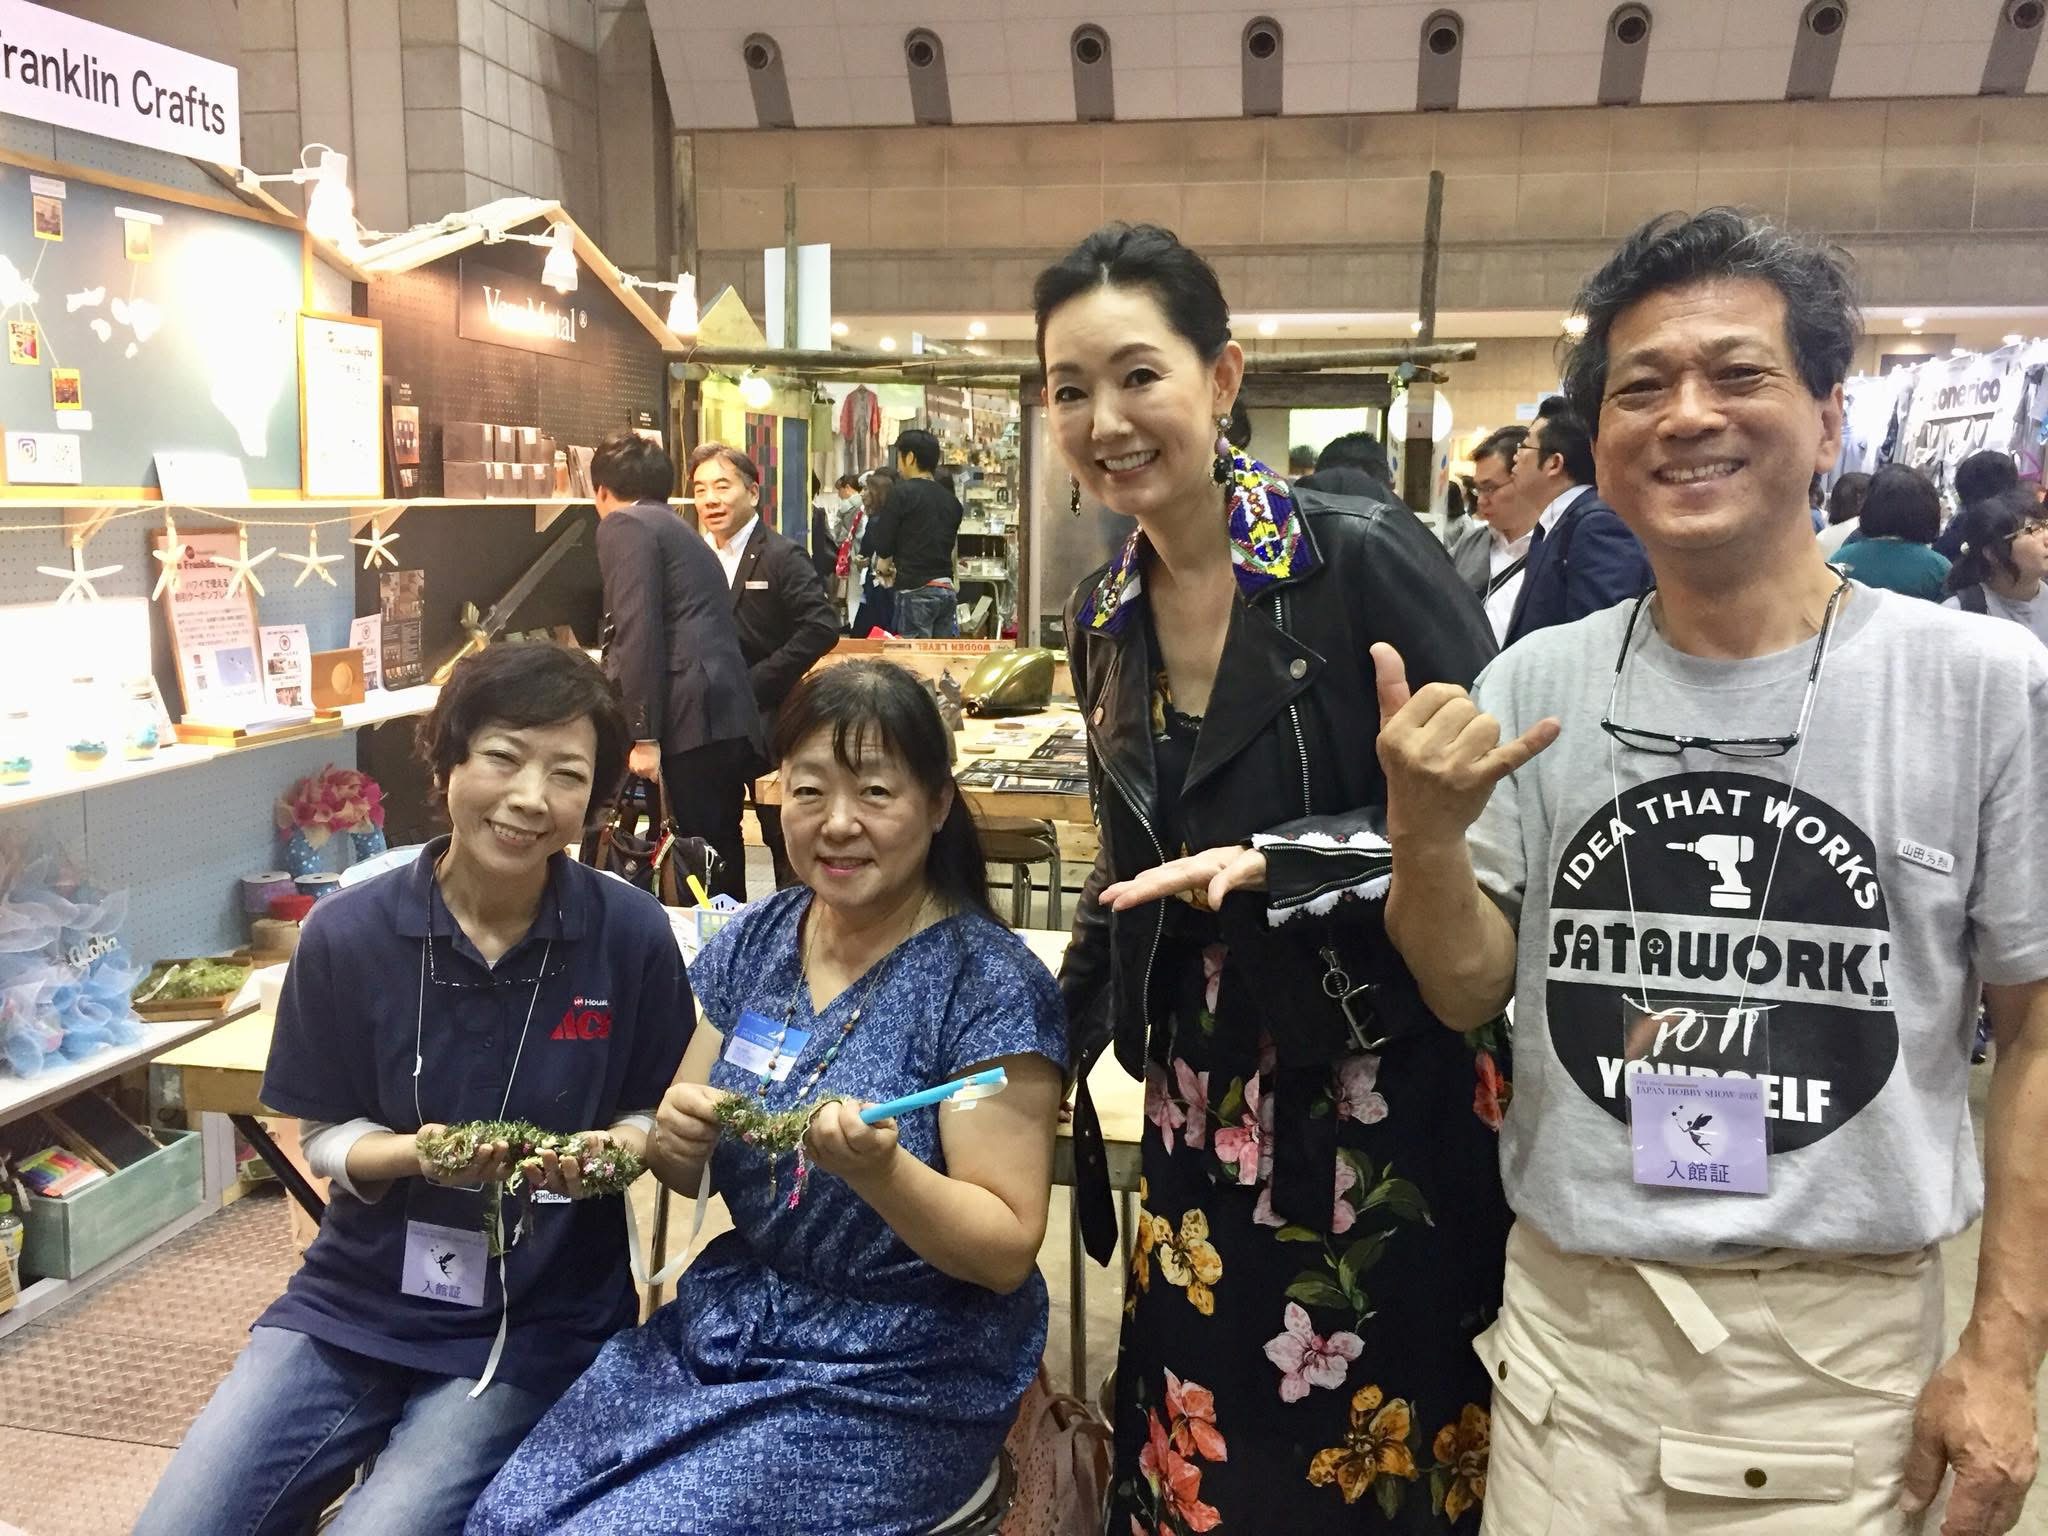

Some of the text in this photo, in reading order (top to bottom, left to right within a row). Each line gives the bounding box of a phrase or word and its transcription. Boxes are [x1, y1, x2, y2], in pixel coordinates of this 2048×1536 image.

[0, 29, 226, 135] ranklin Crafts
[951, 643, 991, 651] WOODEN
[1562, 788, 1879, 911] IDEA THAT WORKS
[1597, 1056, 1831, 1123] YELF
[1636, 1085, 1665, 1096] JAPAN
[1668, 1087, 1702, 1097] HOBBY
[1705, 1089, 1736, 1099] SHOW
[1667, 1160, 1731, 1184] 入館証
[421, 1280, 463, 1299] 入館証
